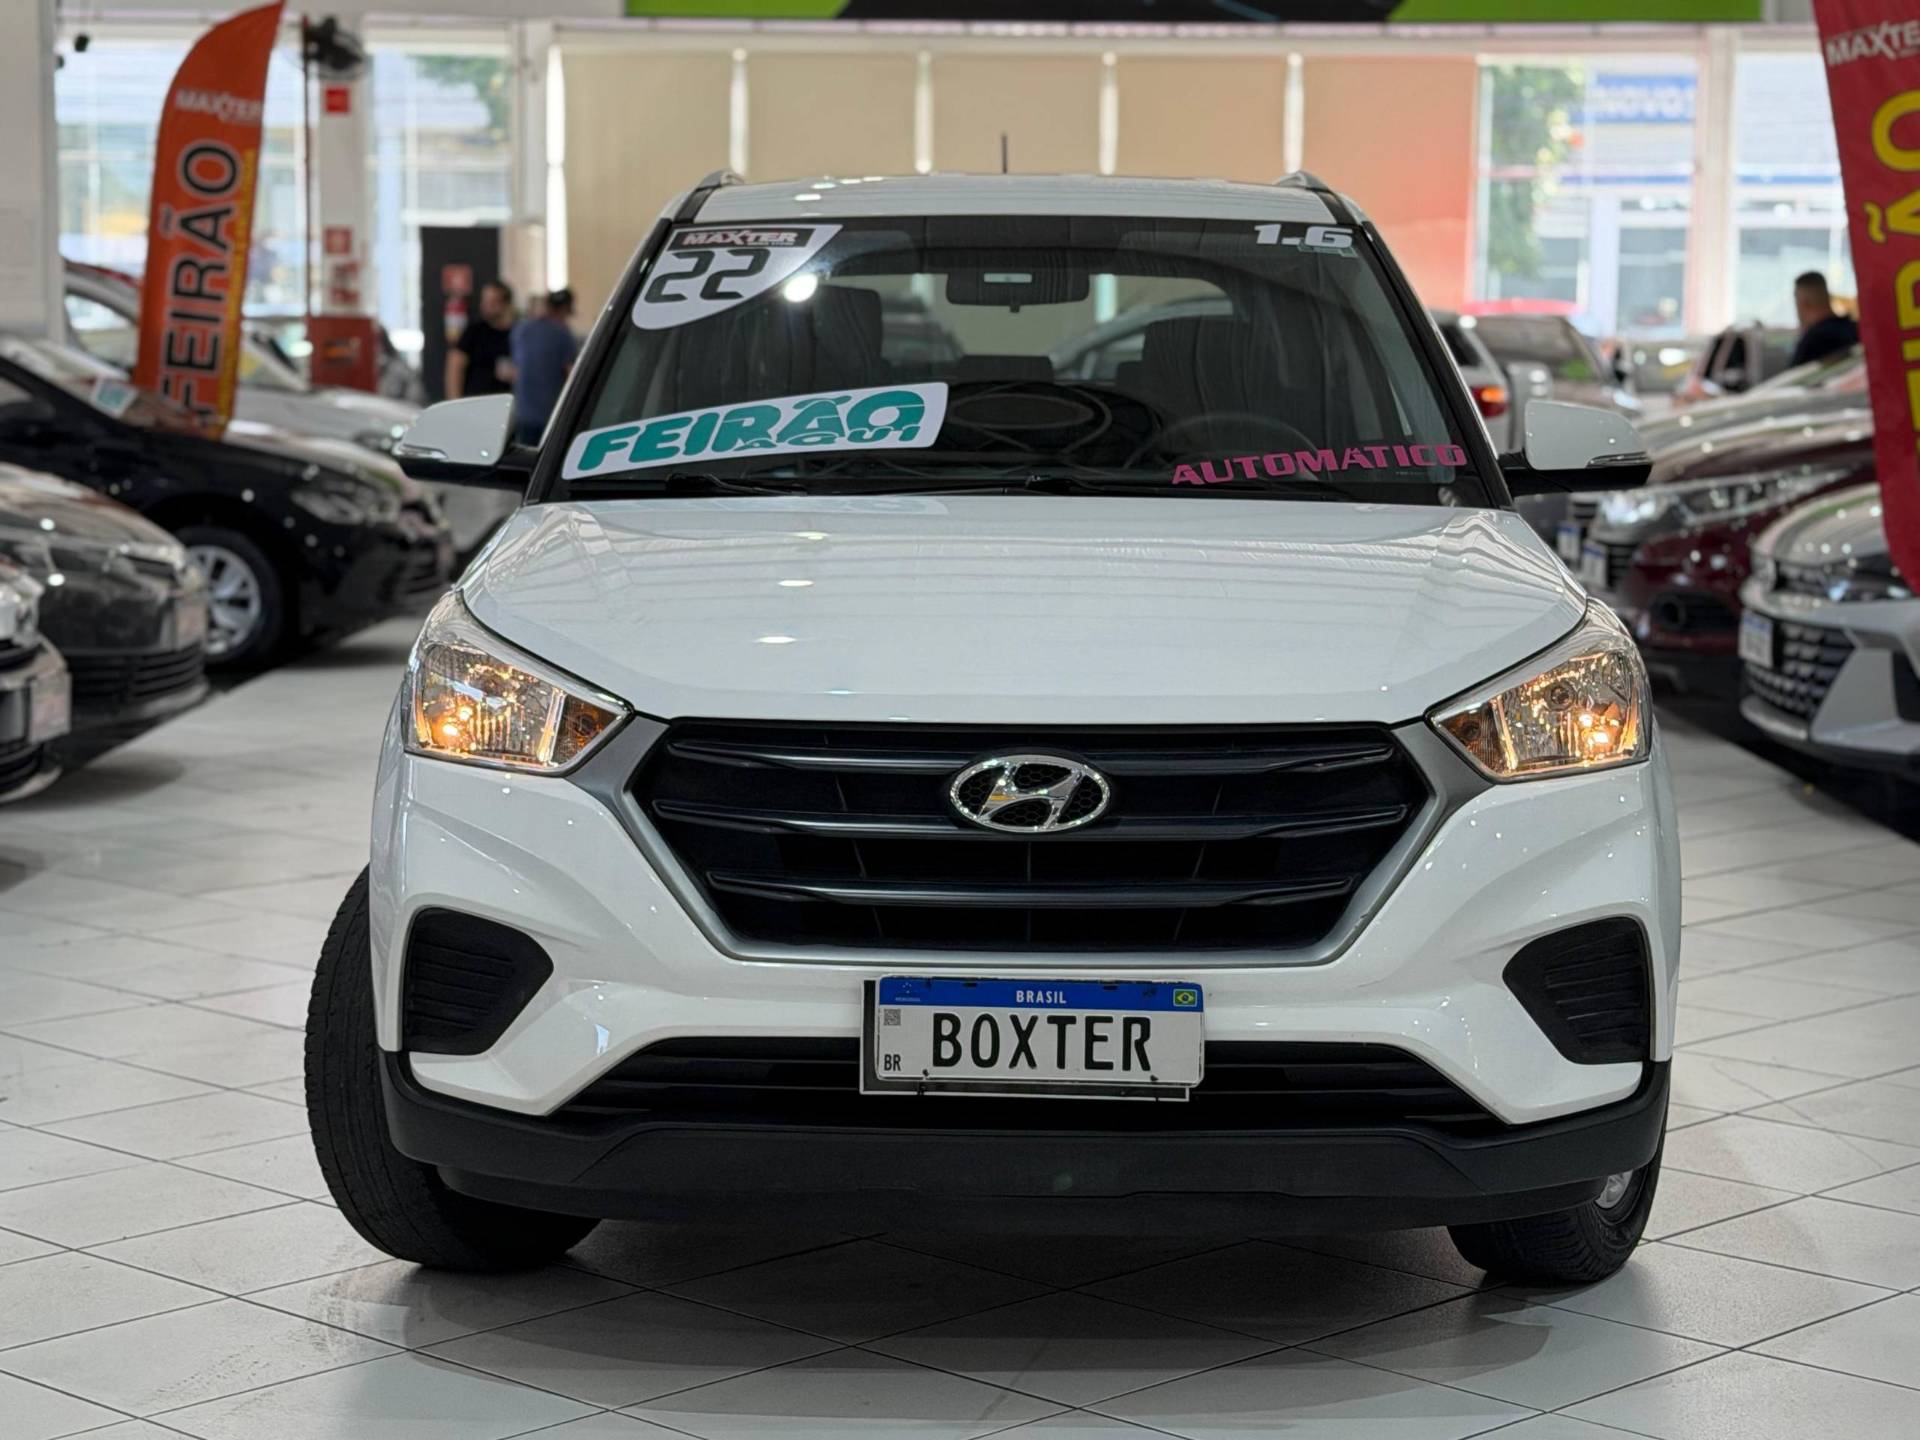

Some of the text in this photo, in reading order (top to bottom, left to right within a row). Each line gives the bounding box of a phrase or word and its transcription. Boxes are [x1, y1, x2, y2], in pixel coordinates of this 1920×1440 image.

[683, 230, 798, 246] MAXTER
[1254, 223, 1353, 248] 1.6
[158, 140, 242, 426] FEIRÃO
[644, 249, 770, 303] 22
[577, 390, 925, 471] FEIRÃO
[1015, 989, 1067, 1004] BRASIL
[932, 1012, 1152, 1072] BOXTER
[883, 1053, 901, 1072] BR
